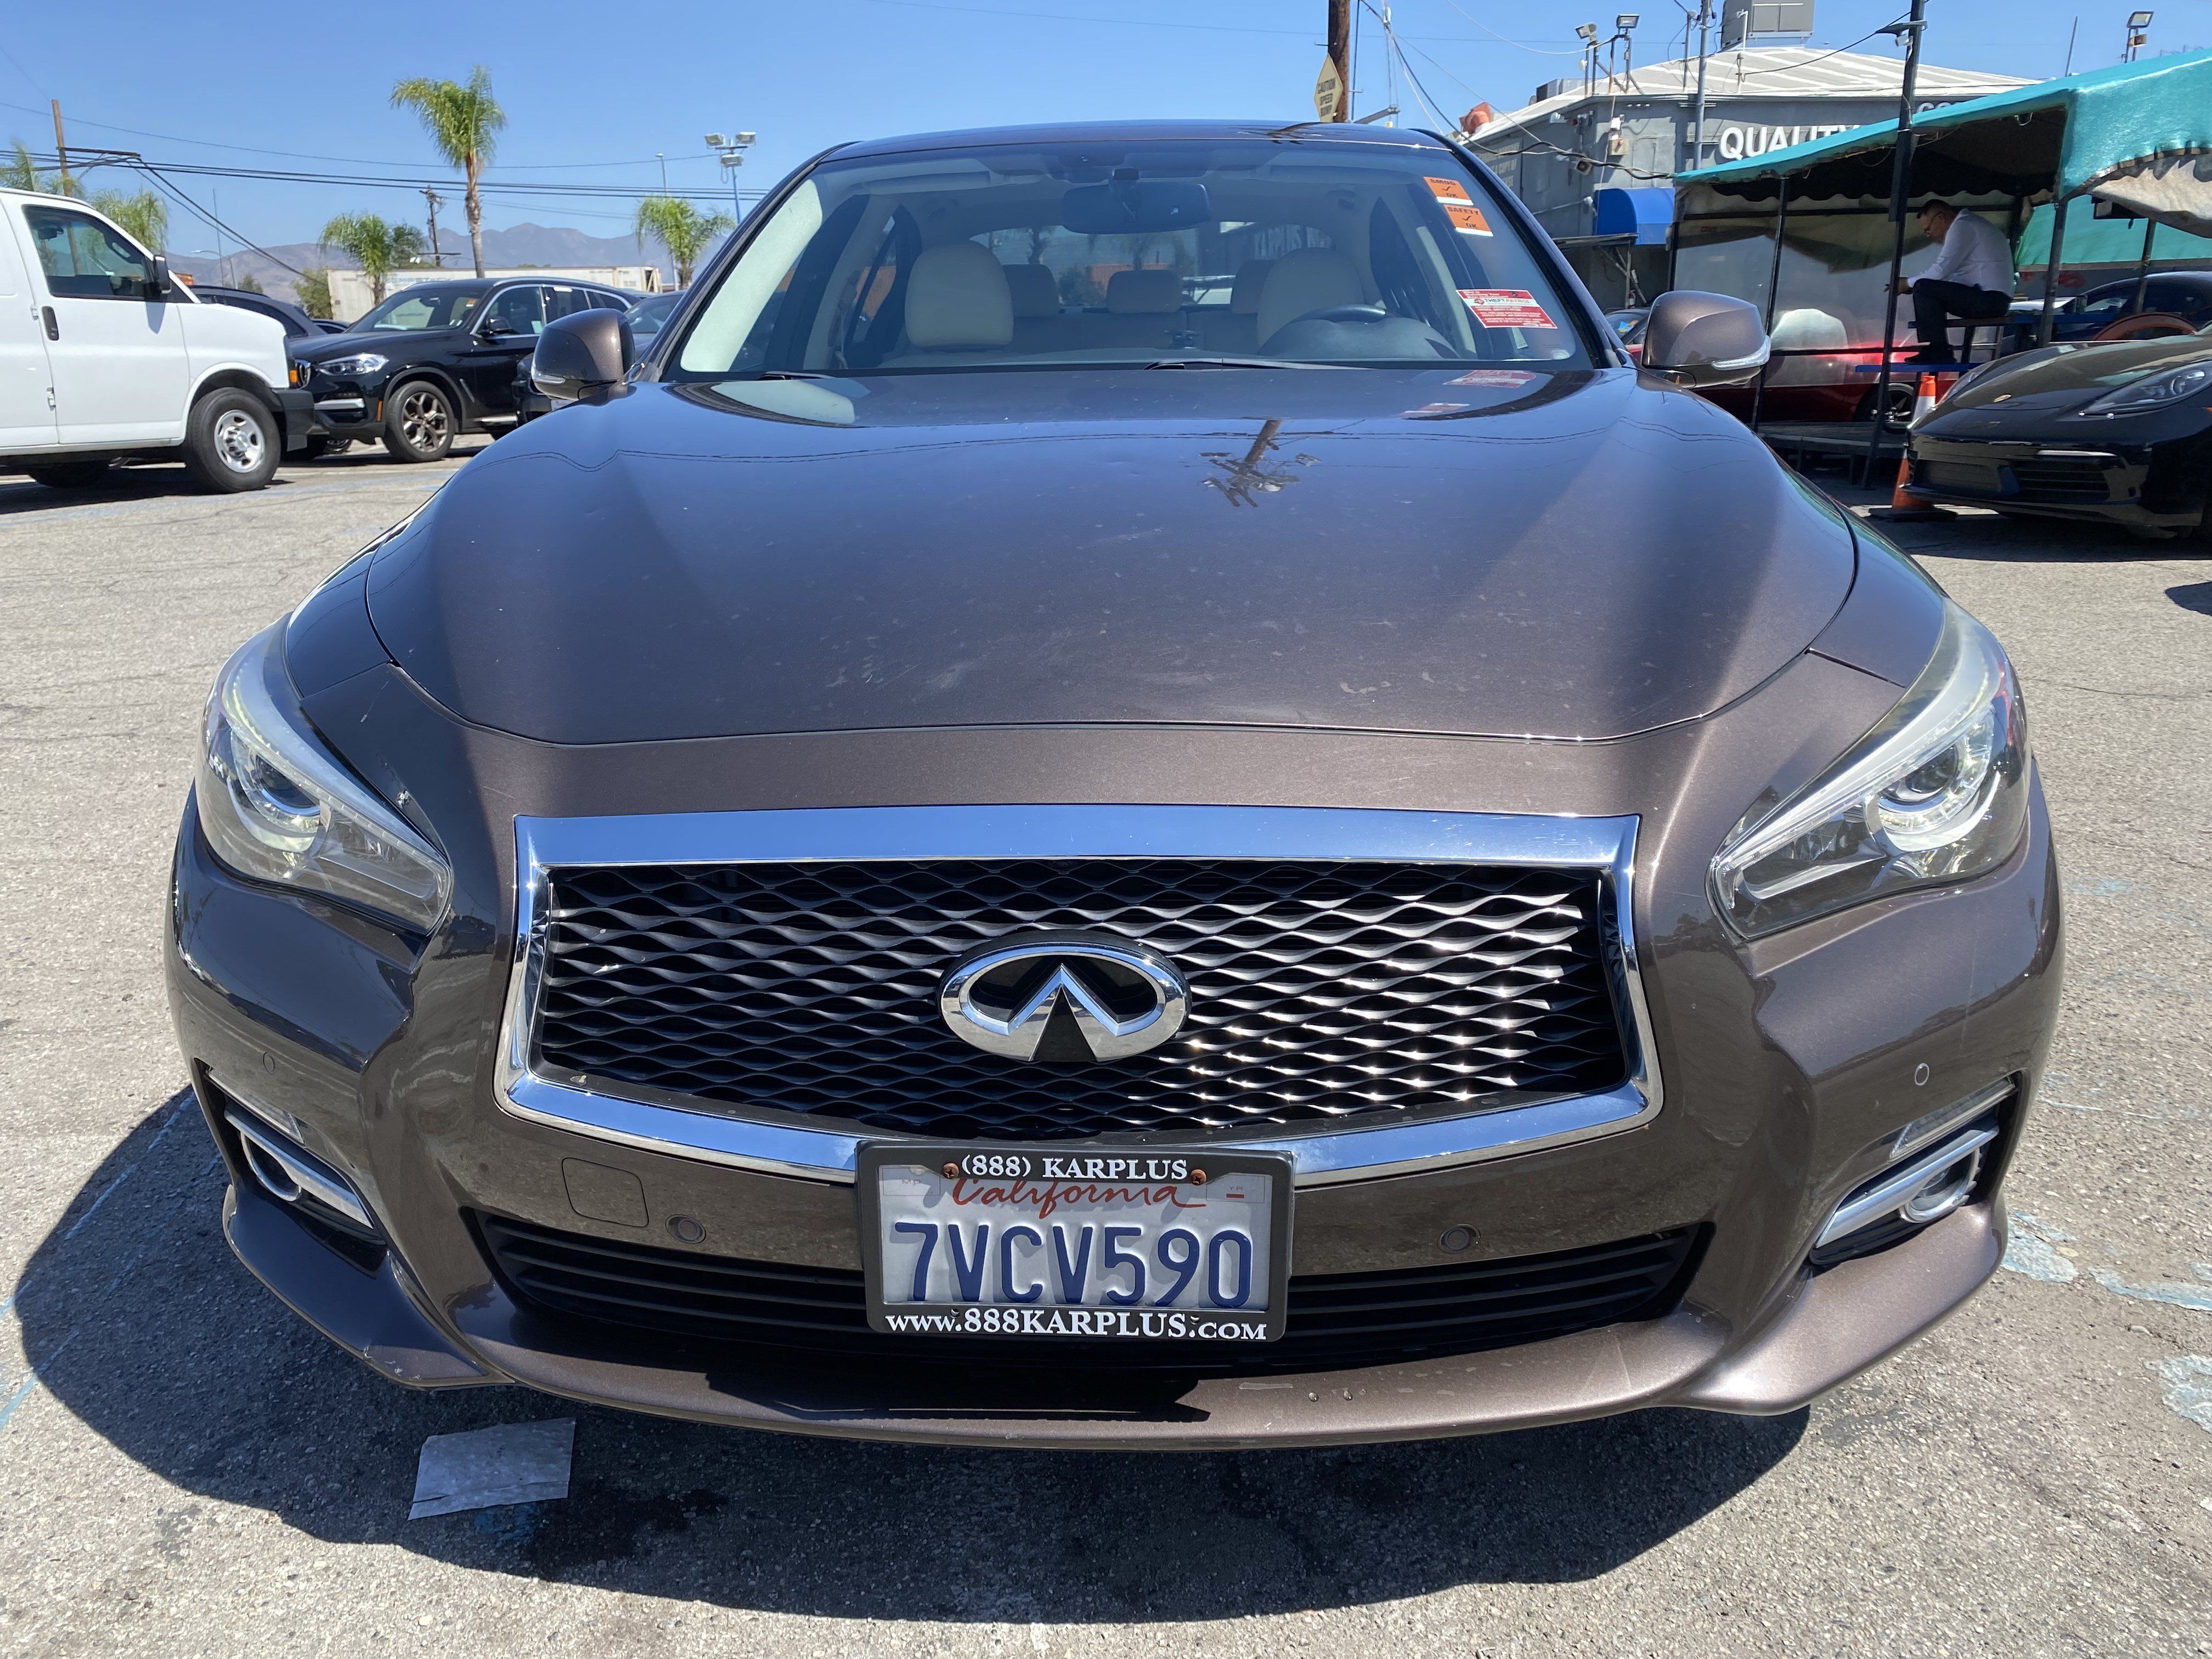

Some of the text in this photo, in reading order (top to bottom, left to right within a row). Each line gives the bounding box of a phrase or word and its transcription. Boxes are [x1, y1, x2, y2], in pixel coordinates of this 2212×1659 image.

[961, 1155, 1188, 1181] (888) KARPLUS
[952, 1178, 1206, 1219] California
[895, 1222, 1252, 1307] 7VCV590
